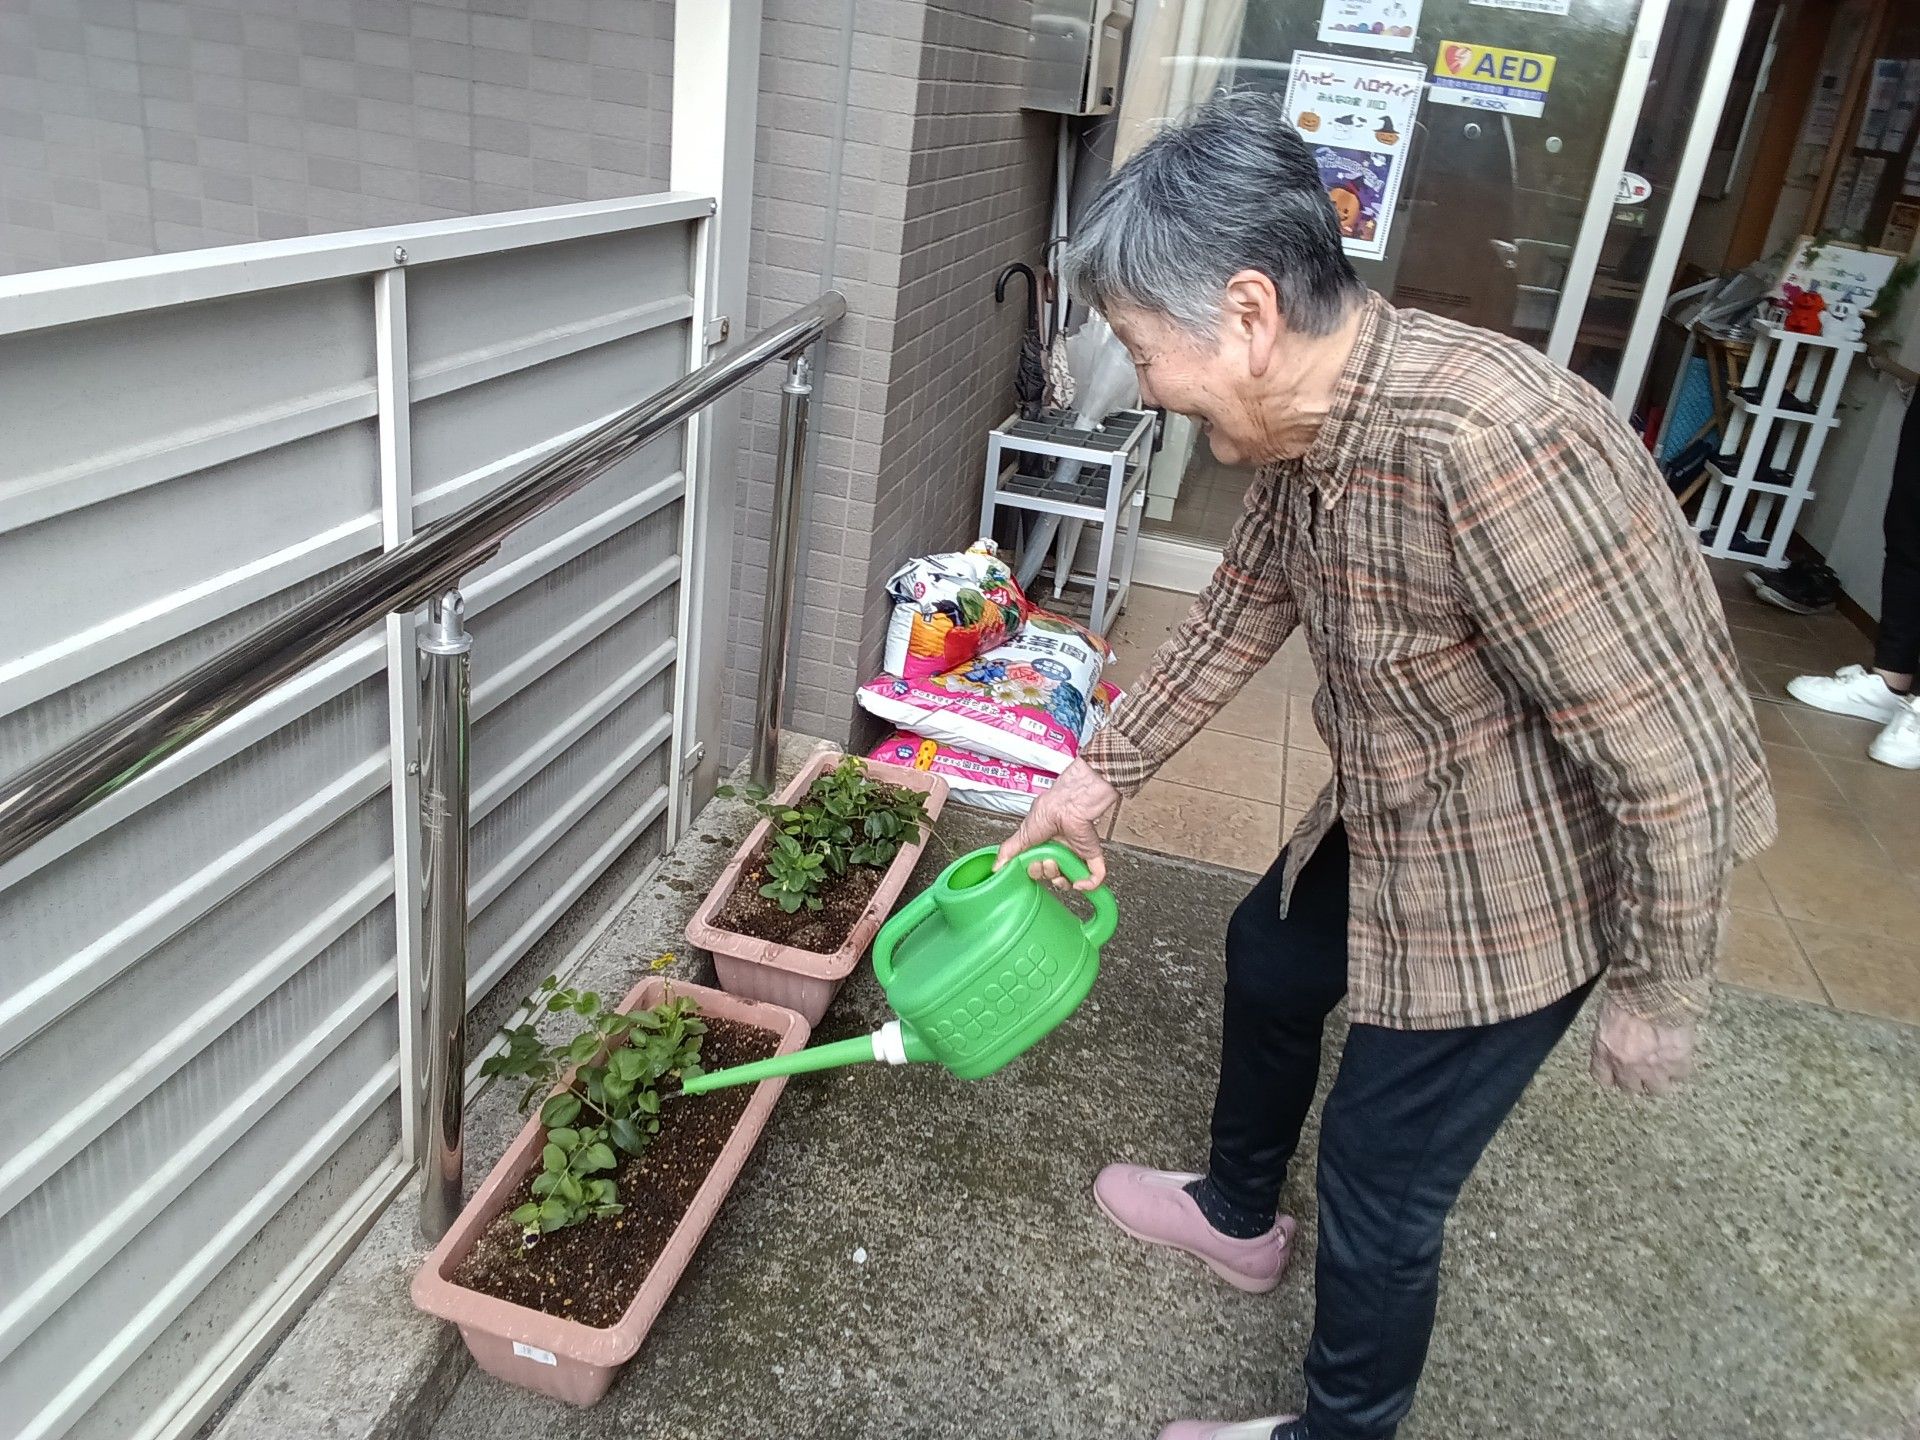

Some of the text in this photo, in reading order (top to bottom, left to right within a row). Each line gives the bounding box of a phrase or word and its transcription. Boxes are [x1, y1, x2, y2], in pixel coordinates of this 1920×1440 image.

[1472, 53, 1543, 83] AED
[1297, 69, 1345, 86] ハッピー
[1353, 77, 1417, 97] ハロウィン
